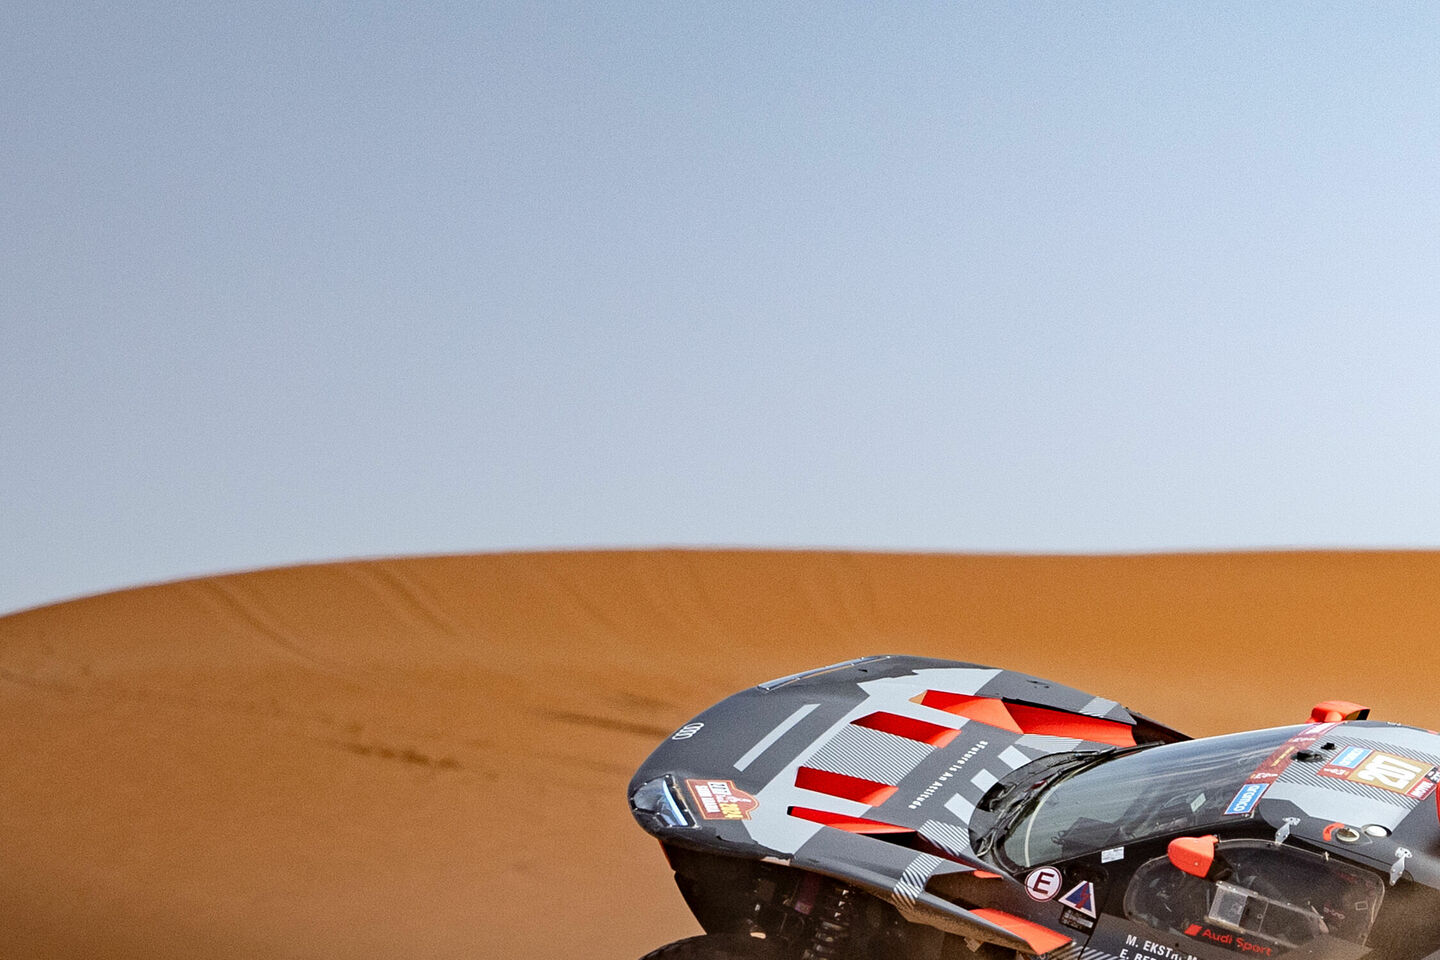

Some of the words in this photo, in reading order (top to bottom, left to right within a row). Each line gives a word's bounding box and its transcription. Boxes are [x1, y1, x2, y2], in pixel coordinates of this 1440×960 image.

[1357, 754, 1422, 789] 207
[908, 781, 943, 809] Attitude
[1033, 872, 1054, 895] E
[1125, 935, 1139, 948] M.
[1202, 929, 1233, 945] Audi
[1236, 937, 1272, 956] Sport
[1119, 949, 1130, 960] E.
